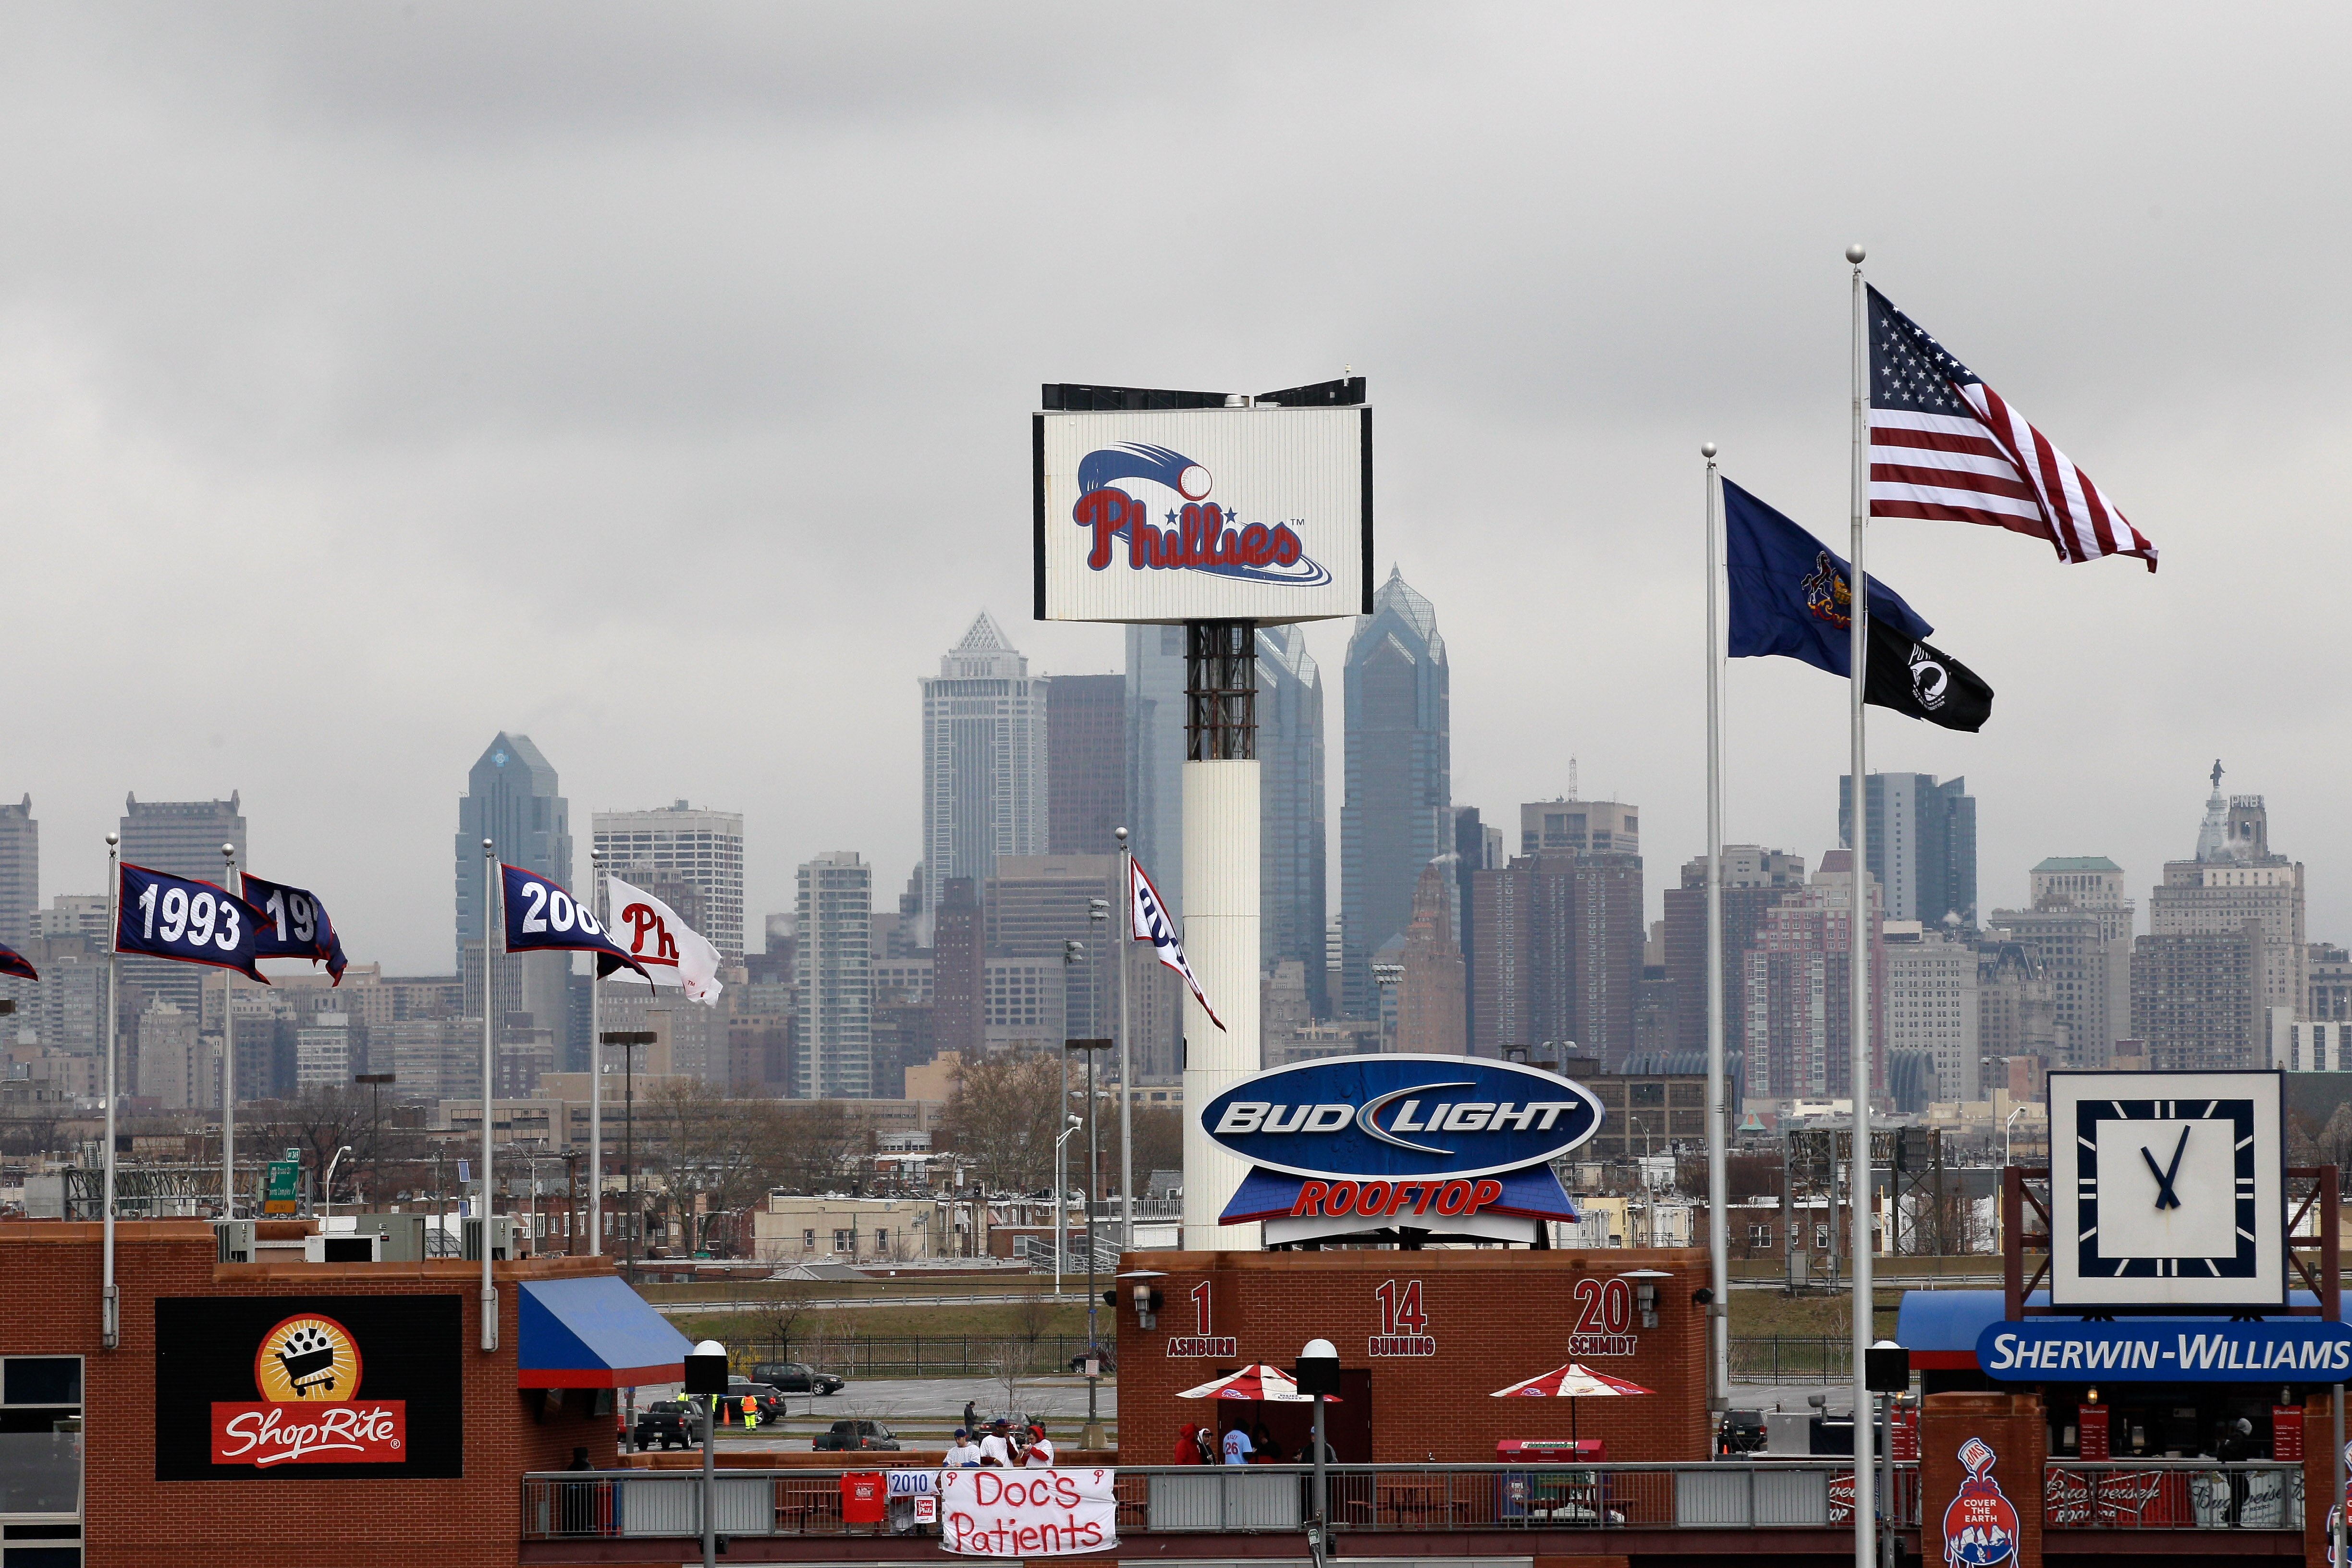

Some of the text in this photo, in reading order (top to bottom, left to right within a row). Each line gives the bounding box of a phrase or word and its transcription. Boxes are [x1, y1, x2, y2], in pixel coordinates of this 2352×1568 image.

[1073, 486, 1302, 571] Phillies
[2230, 795, 2258, 808] PNB
[139, 883, 240, 951] 1993
[687, 980, 696, 988] TM
[1213, 1100, 1579, 1133] BUD LIGHT
[1290, 1180, 1504, 1216] ROOFTOP
[1191, 1281, 1211, 1335] 1
[1376, 1280, 1427, 1335] 14
[1572, 1278, 1631, 1335] 20
[1166, 1337, 1236, 1357] ASHBURN
[1369, 1336, 1435, 1357] BUNNING
[1568, 1335, 1637, 1356] SCHMIDT
[222, 1406, 394, 1463] ShopRite
[1225, 1442, 1238, 1455] 26
[1967, 1444, 1985, 1465] SWP
[892, 1474, 928, 1492] 2010
[949, 1512, 1103, 1556] Patients
